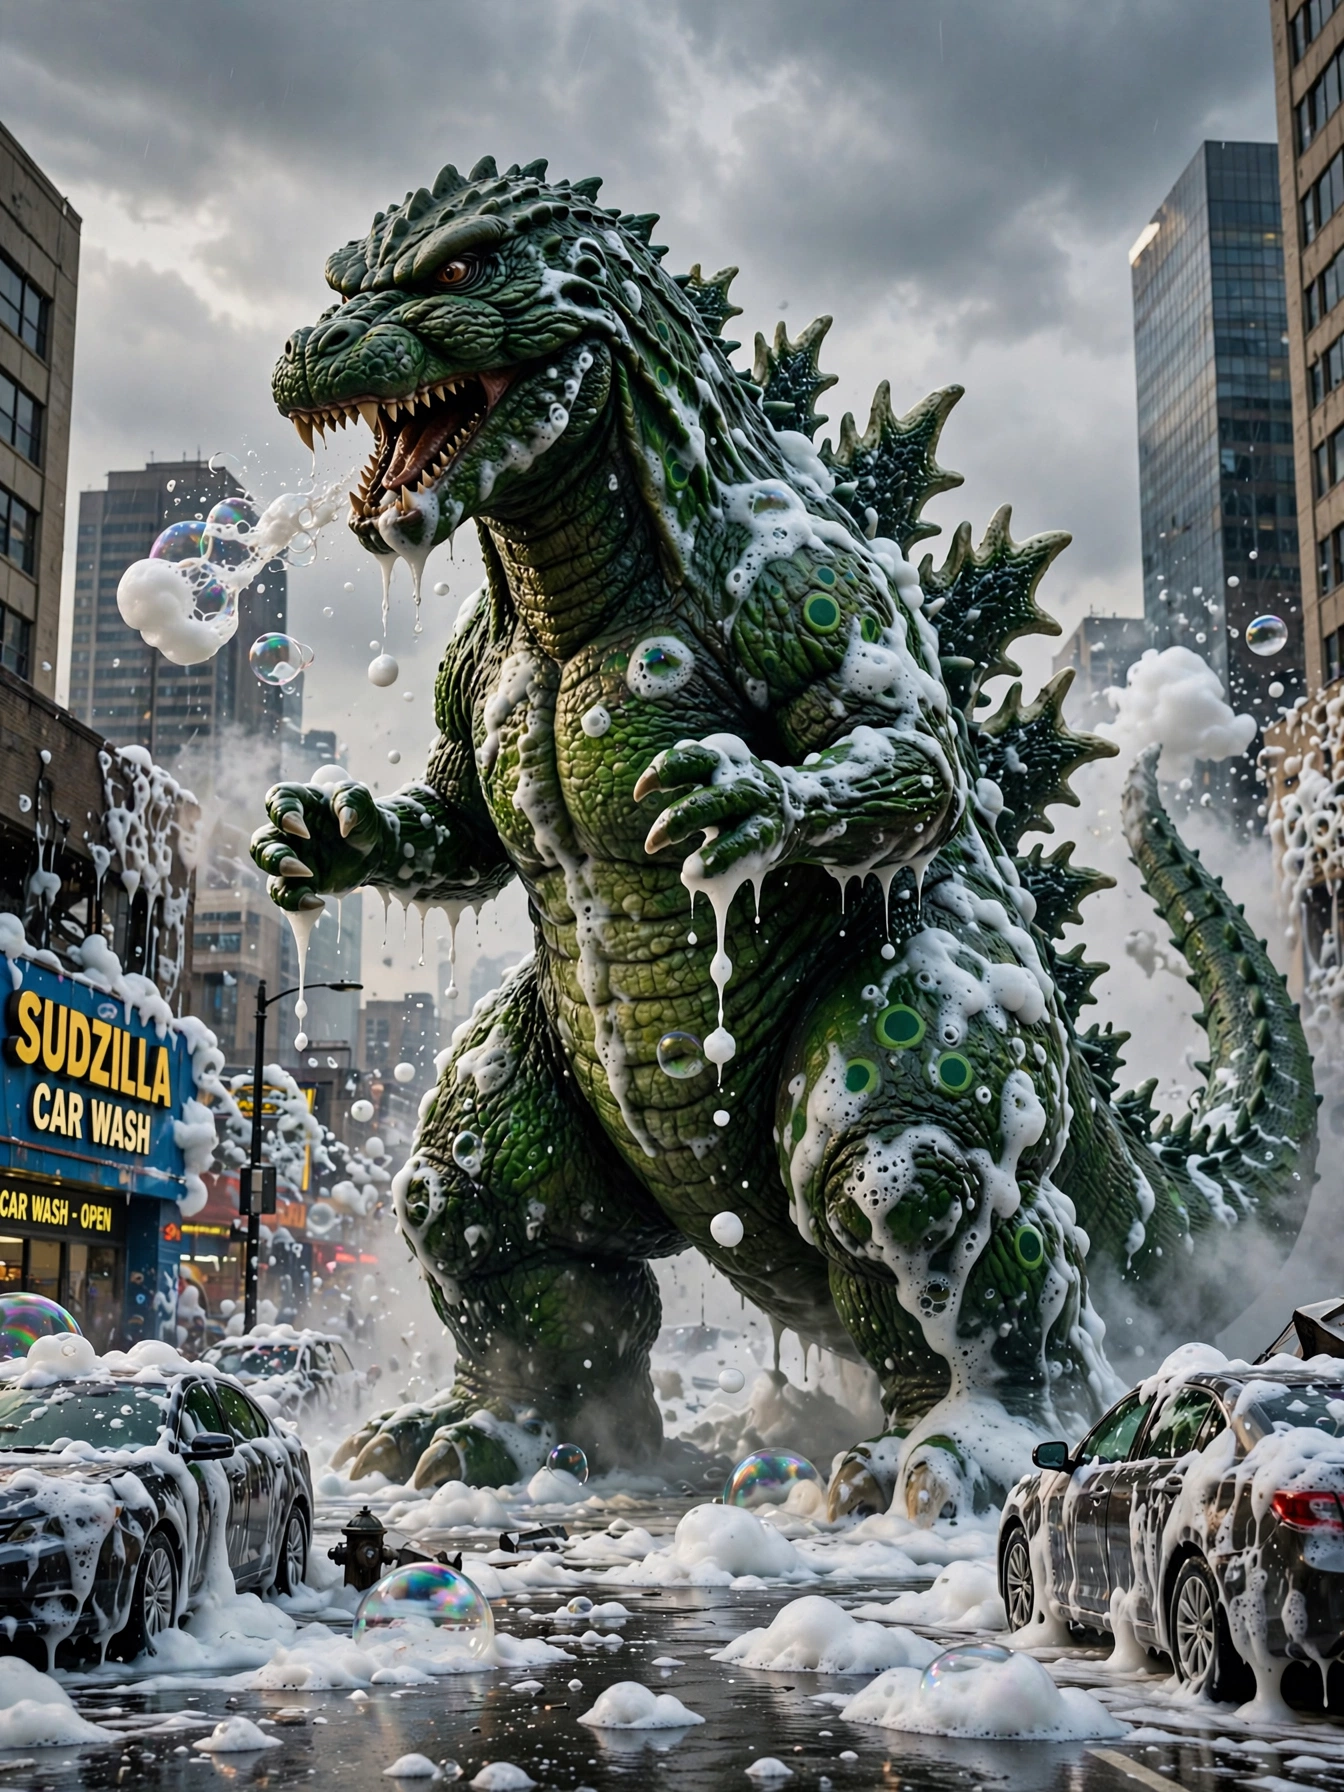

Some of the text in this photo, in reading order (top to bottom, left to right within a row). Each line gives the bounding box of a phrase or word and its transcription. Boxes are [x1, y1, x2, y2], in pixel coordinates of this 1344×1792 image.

[15, 990, 172, 1108] SUDZILLA
[32, 1082, 151, 1155] CAR WASH
[0, 1189, 28, 1220] CAR
[32, 1194, 69, 1226] WASH
[80, 1202, 112, 1232] OPEN
